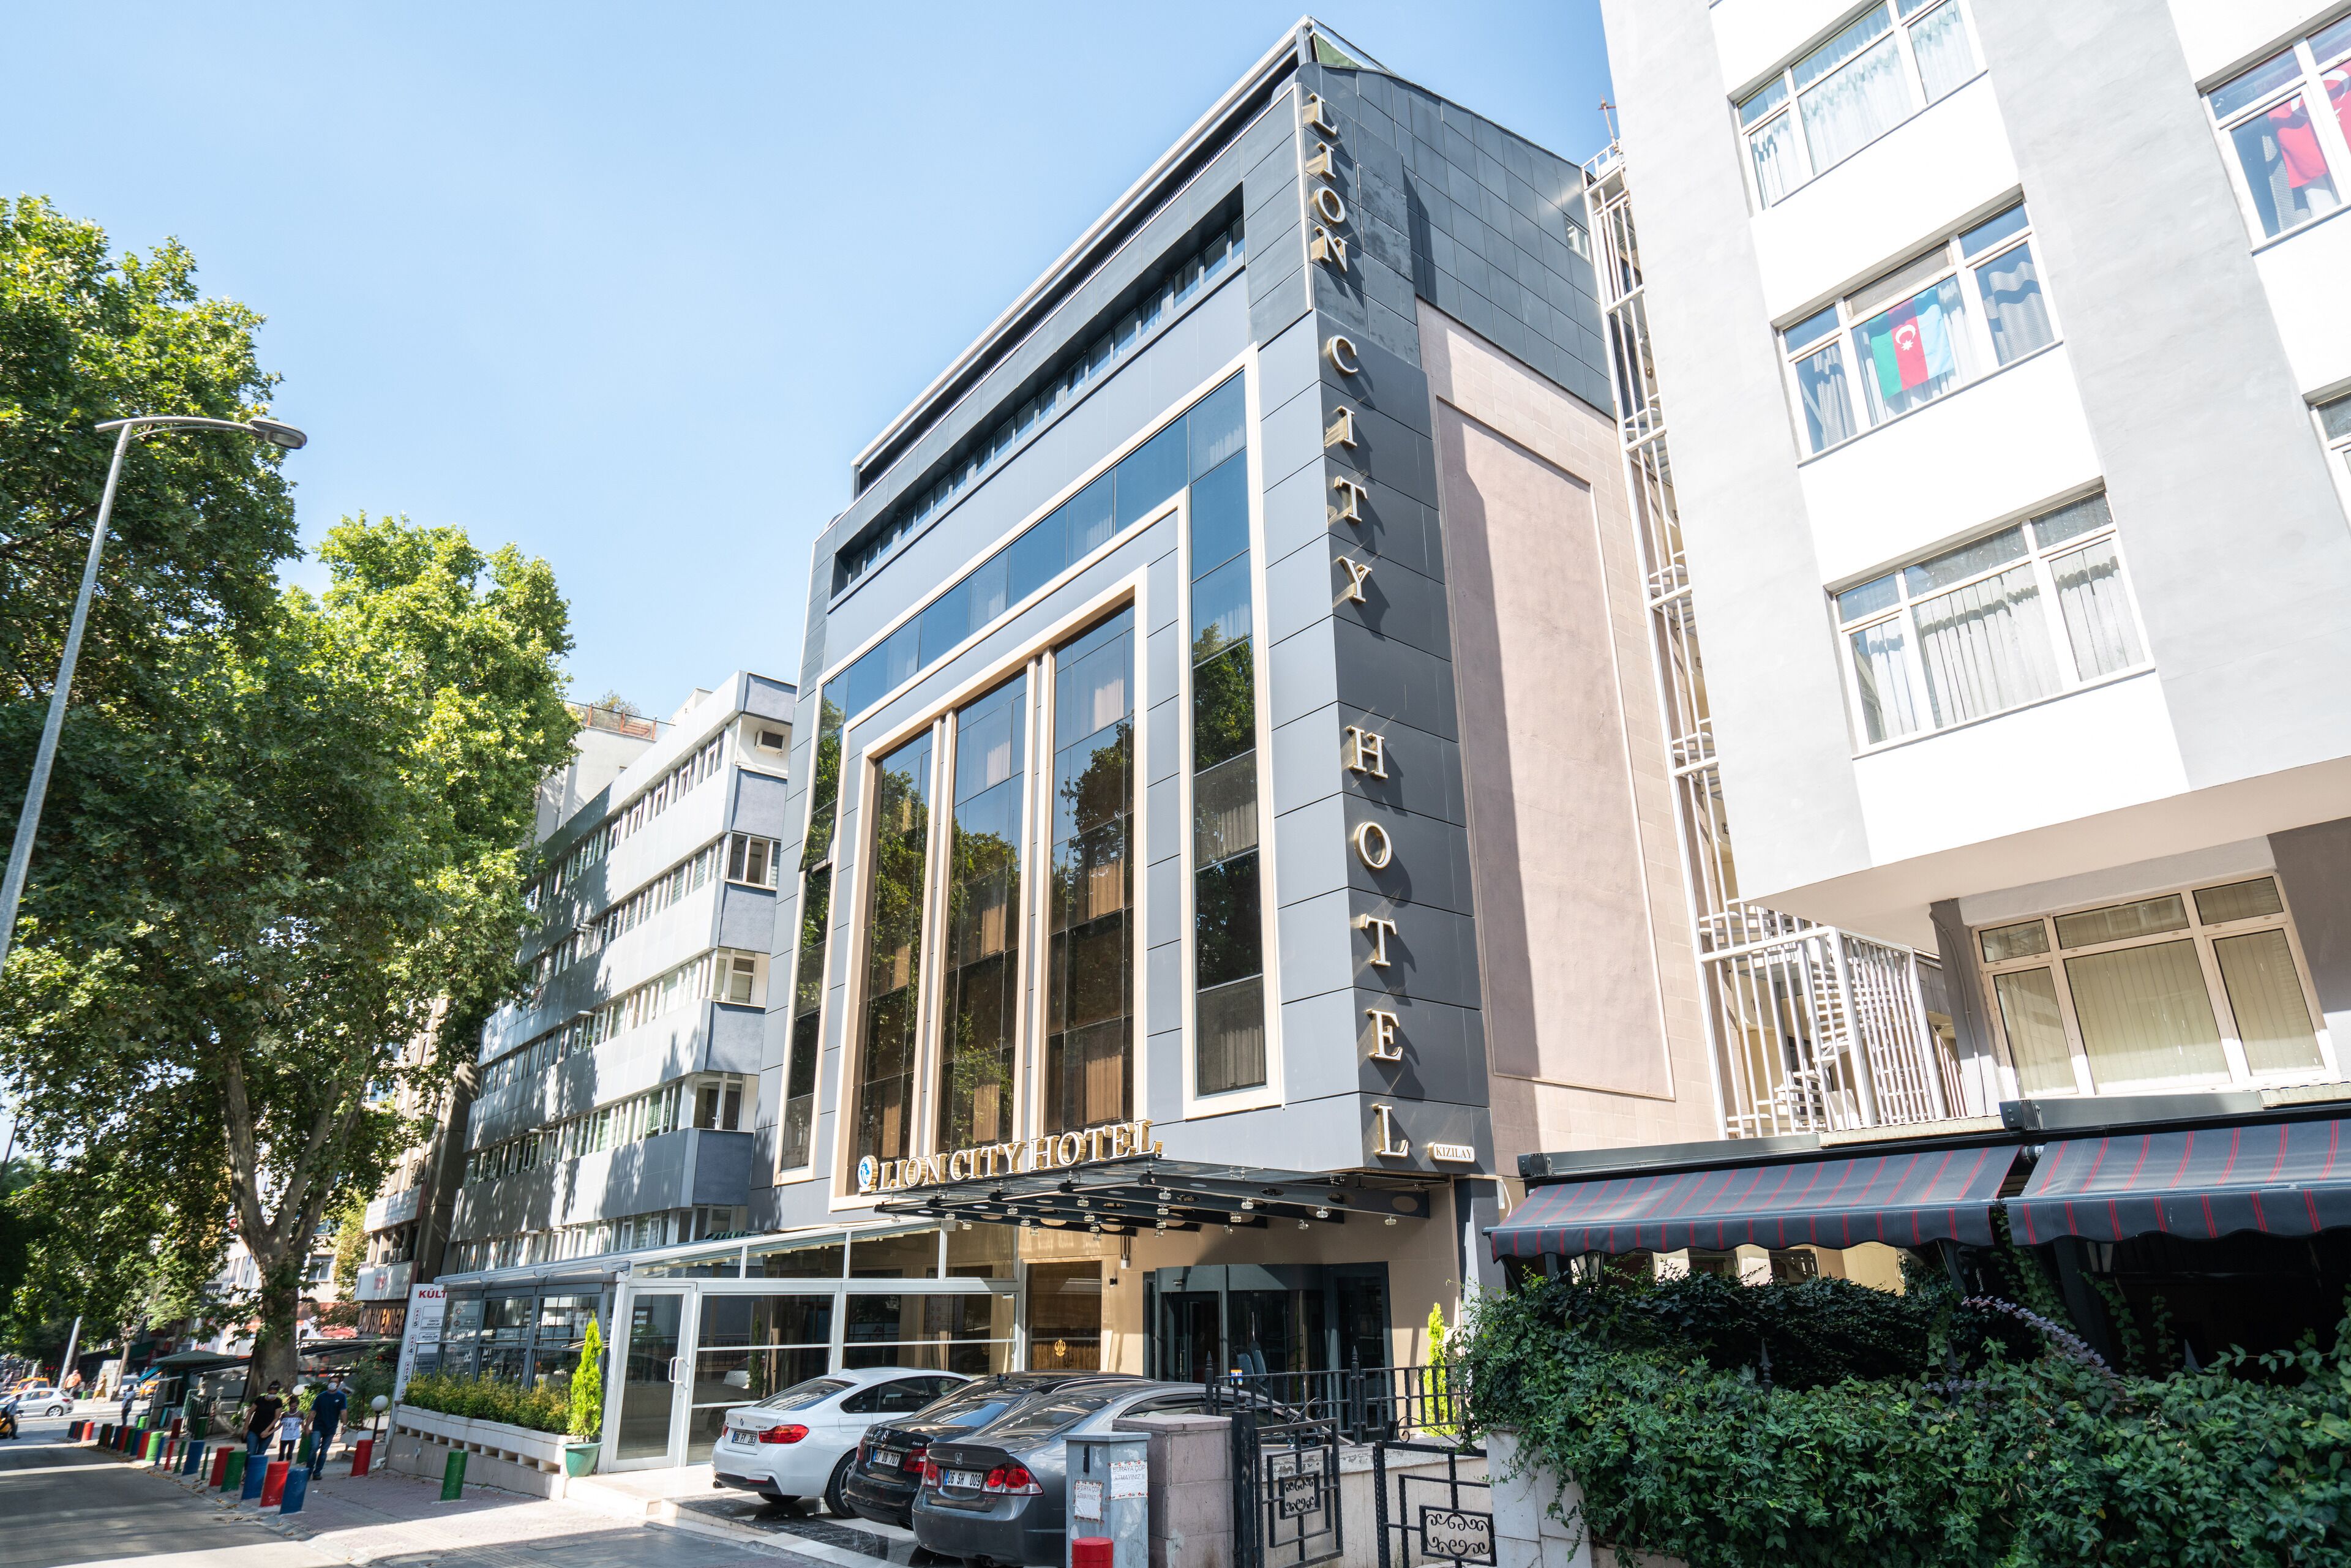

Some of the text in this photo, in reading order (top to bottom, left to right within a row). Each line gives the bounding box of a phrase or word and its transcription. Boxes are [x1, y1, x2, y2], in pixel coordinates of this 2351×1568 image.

[1308, 92, 1409, 1157] LION CITY HOTEL
[880, 1119, 1163, 1190] LION CITY HOTEL
[1436, 1147, 1472, 1159] KIZILAY
[889, 1454, 899, 1465] 707
[948, 1471, 981, 1487] 06 SH 009
